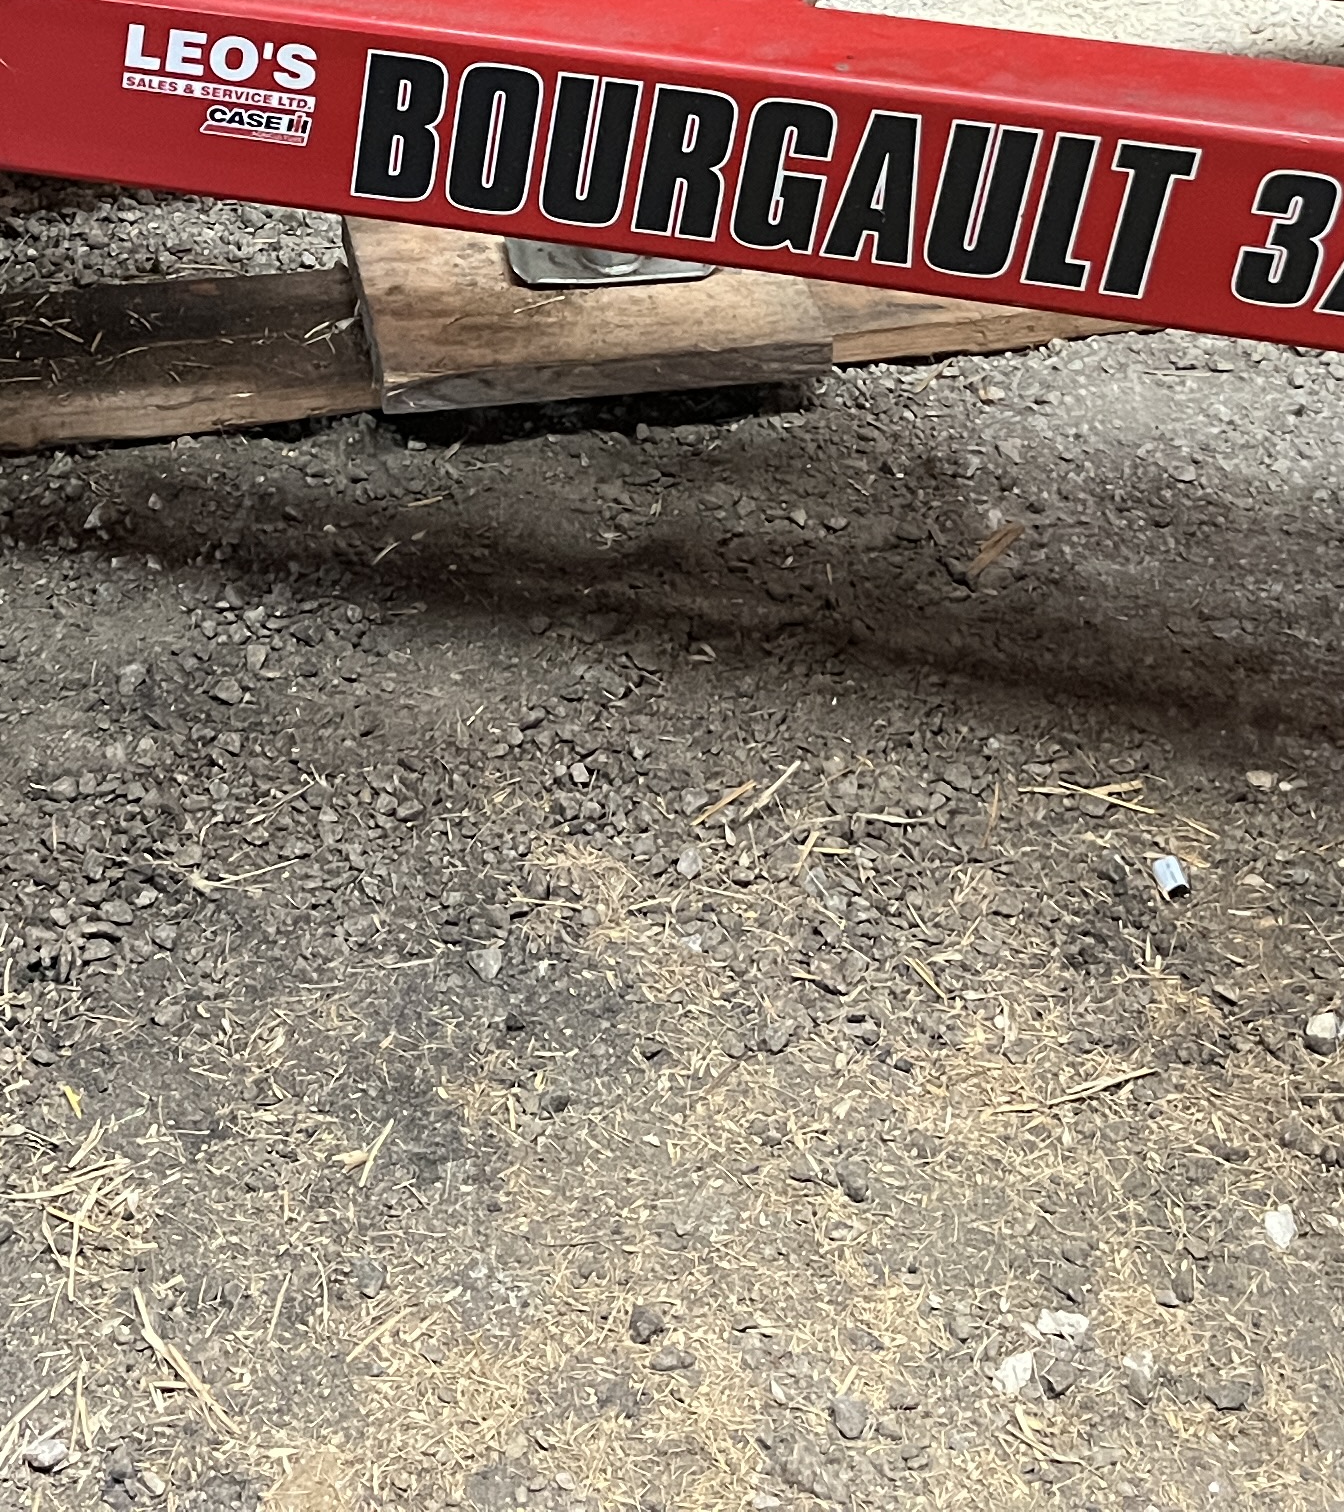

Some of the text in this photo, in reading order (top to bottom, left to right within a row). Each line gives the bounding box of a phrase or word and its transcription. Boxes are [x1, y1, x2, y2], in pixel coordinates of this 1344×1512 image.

[124, 23, 318, 90] LEO'S
[126, 76, 312, 110] SALES & SERVICE LTD.
[208, 107, 283, 131] CASE
[350, 48, 1204, 300] BOURGAULT
